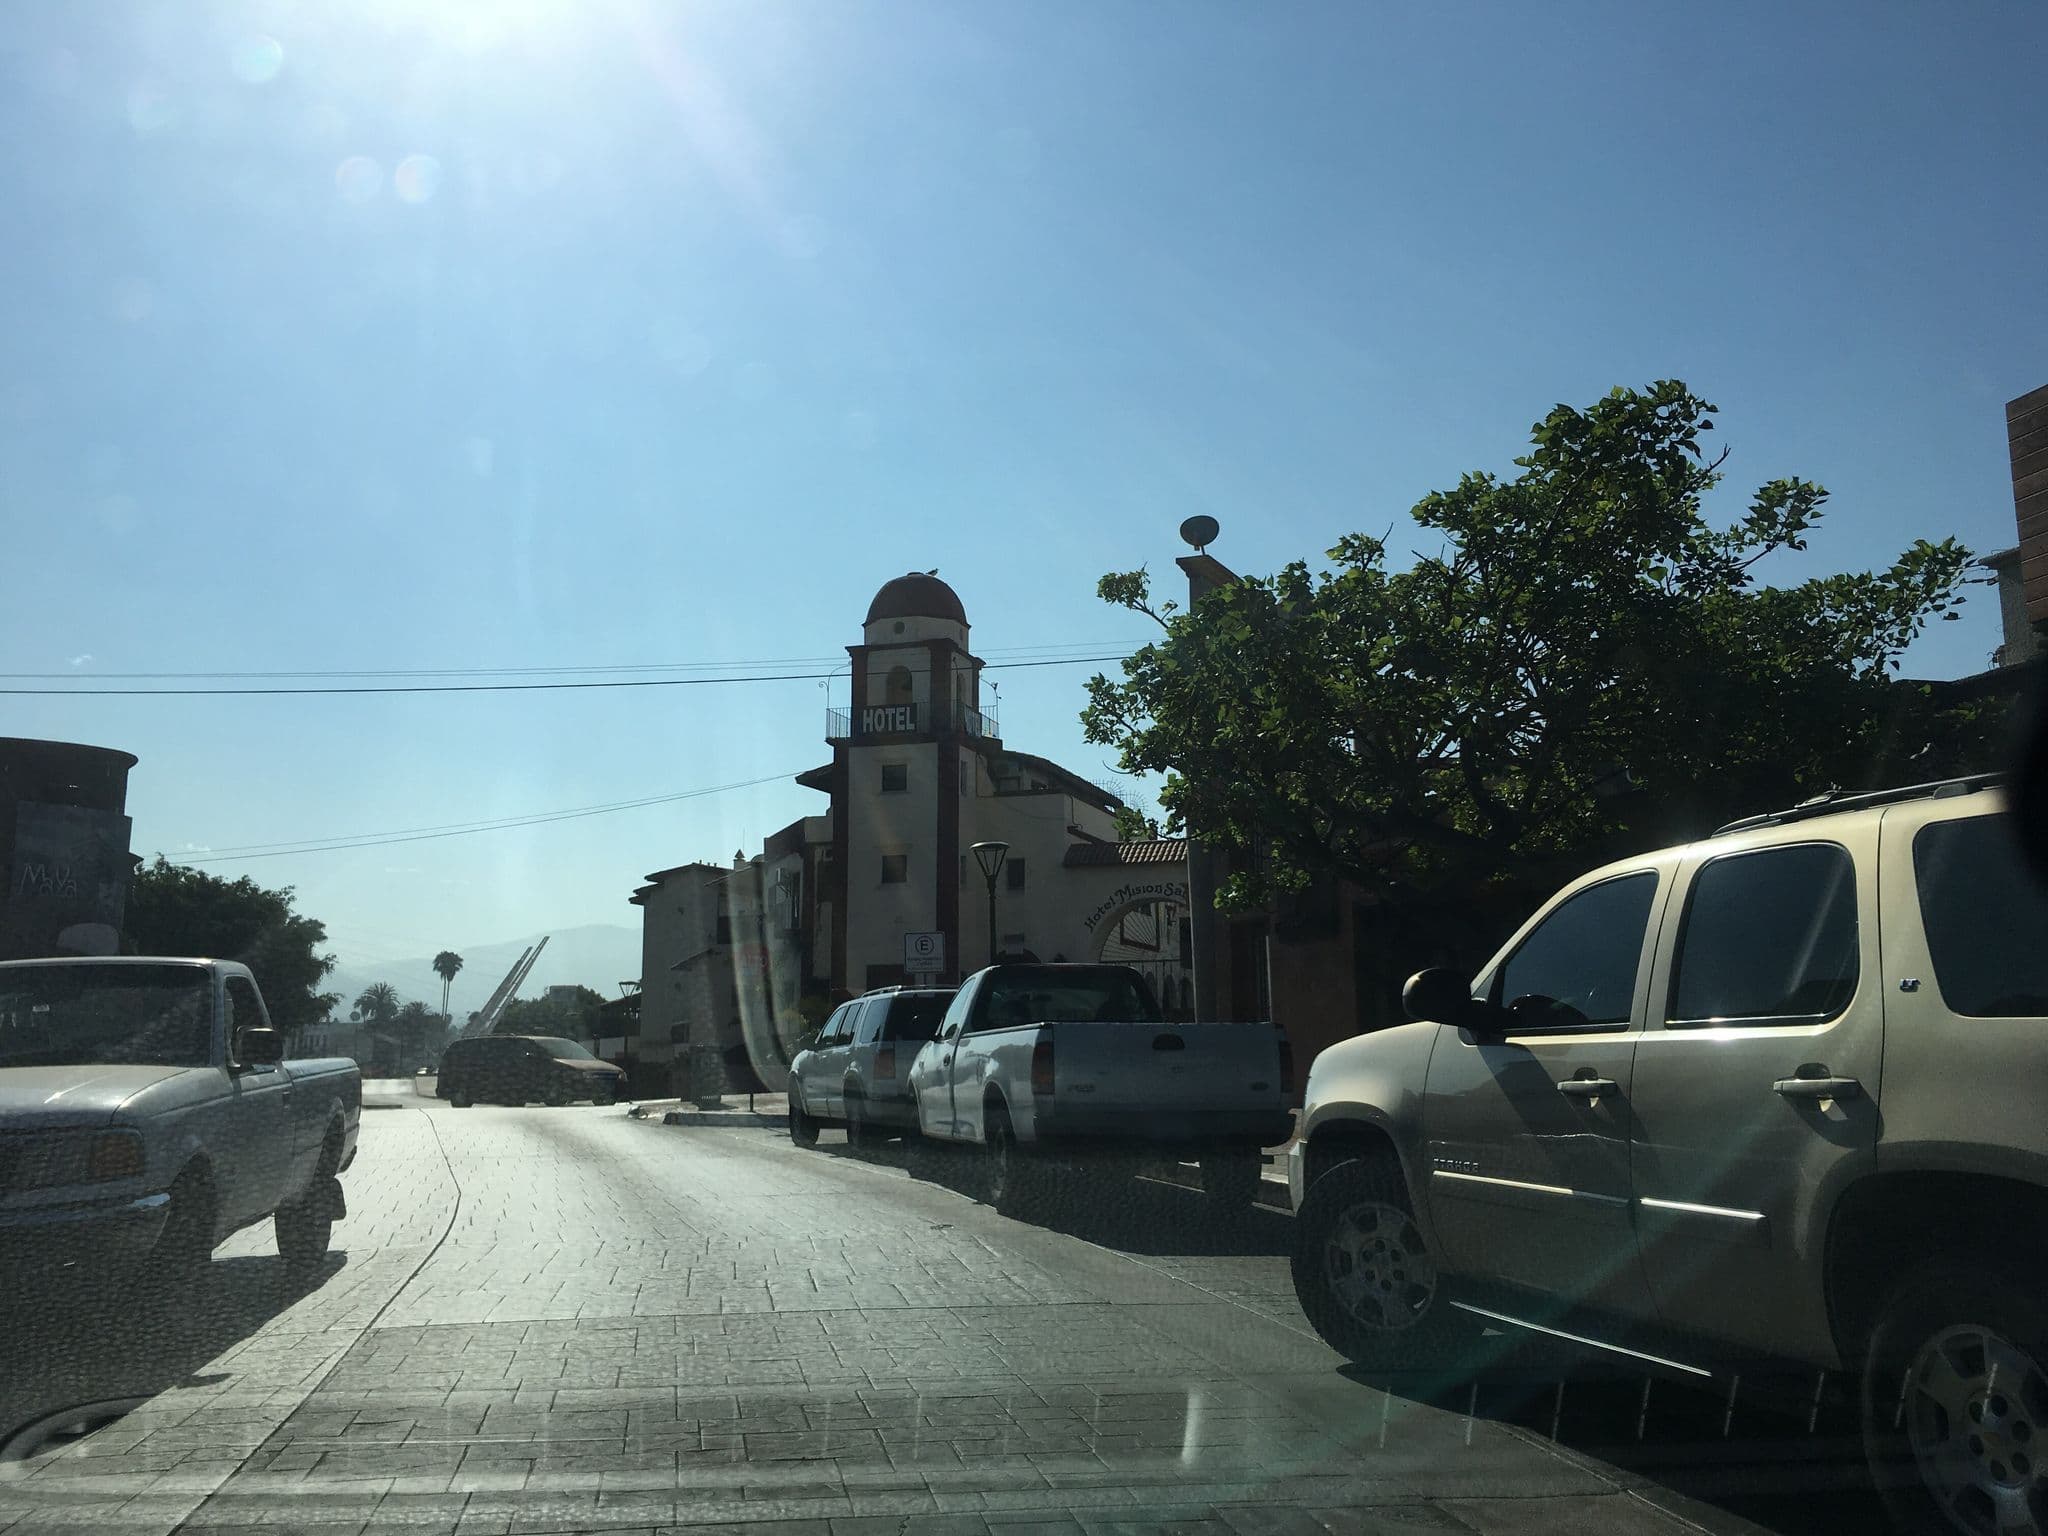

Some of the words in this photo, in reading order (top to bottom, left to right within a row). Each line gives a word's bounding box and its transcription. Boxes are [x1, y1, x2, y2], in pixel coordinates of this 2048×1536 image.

[862, 706, 916, 733] HOTEL
[1084, 895, 1116, 933] Hotel
[1163, 882, 1187, 898] Sa
[920, 939, 929, 951] E
